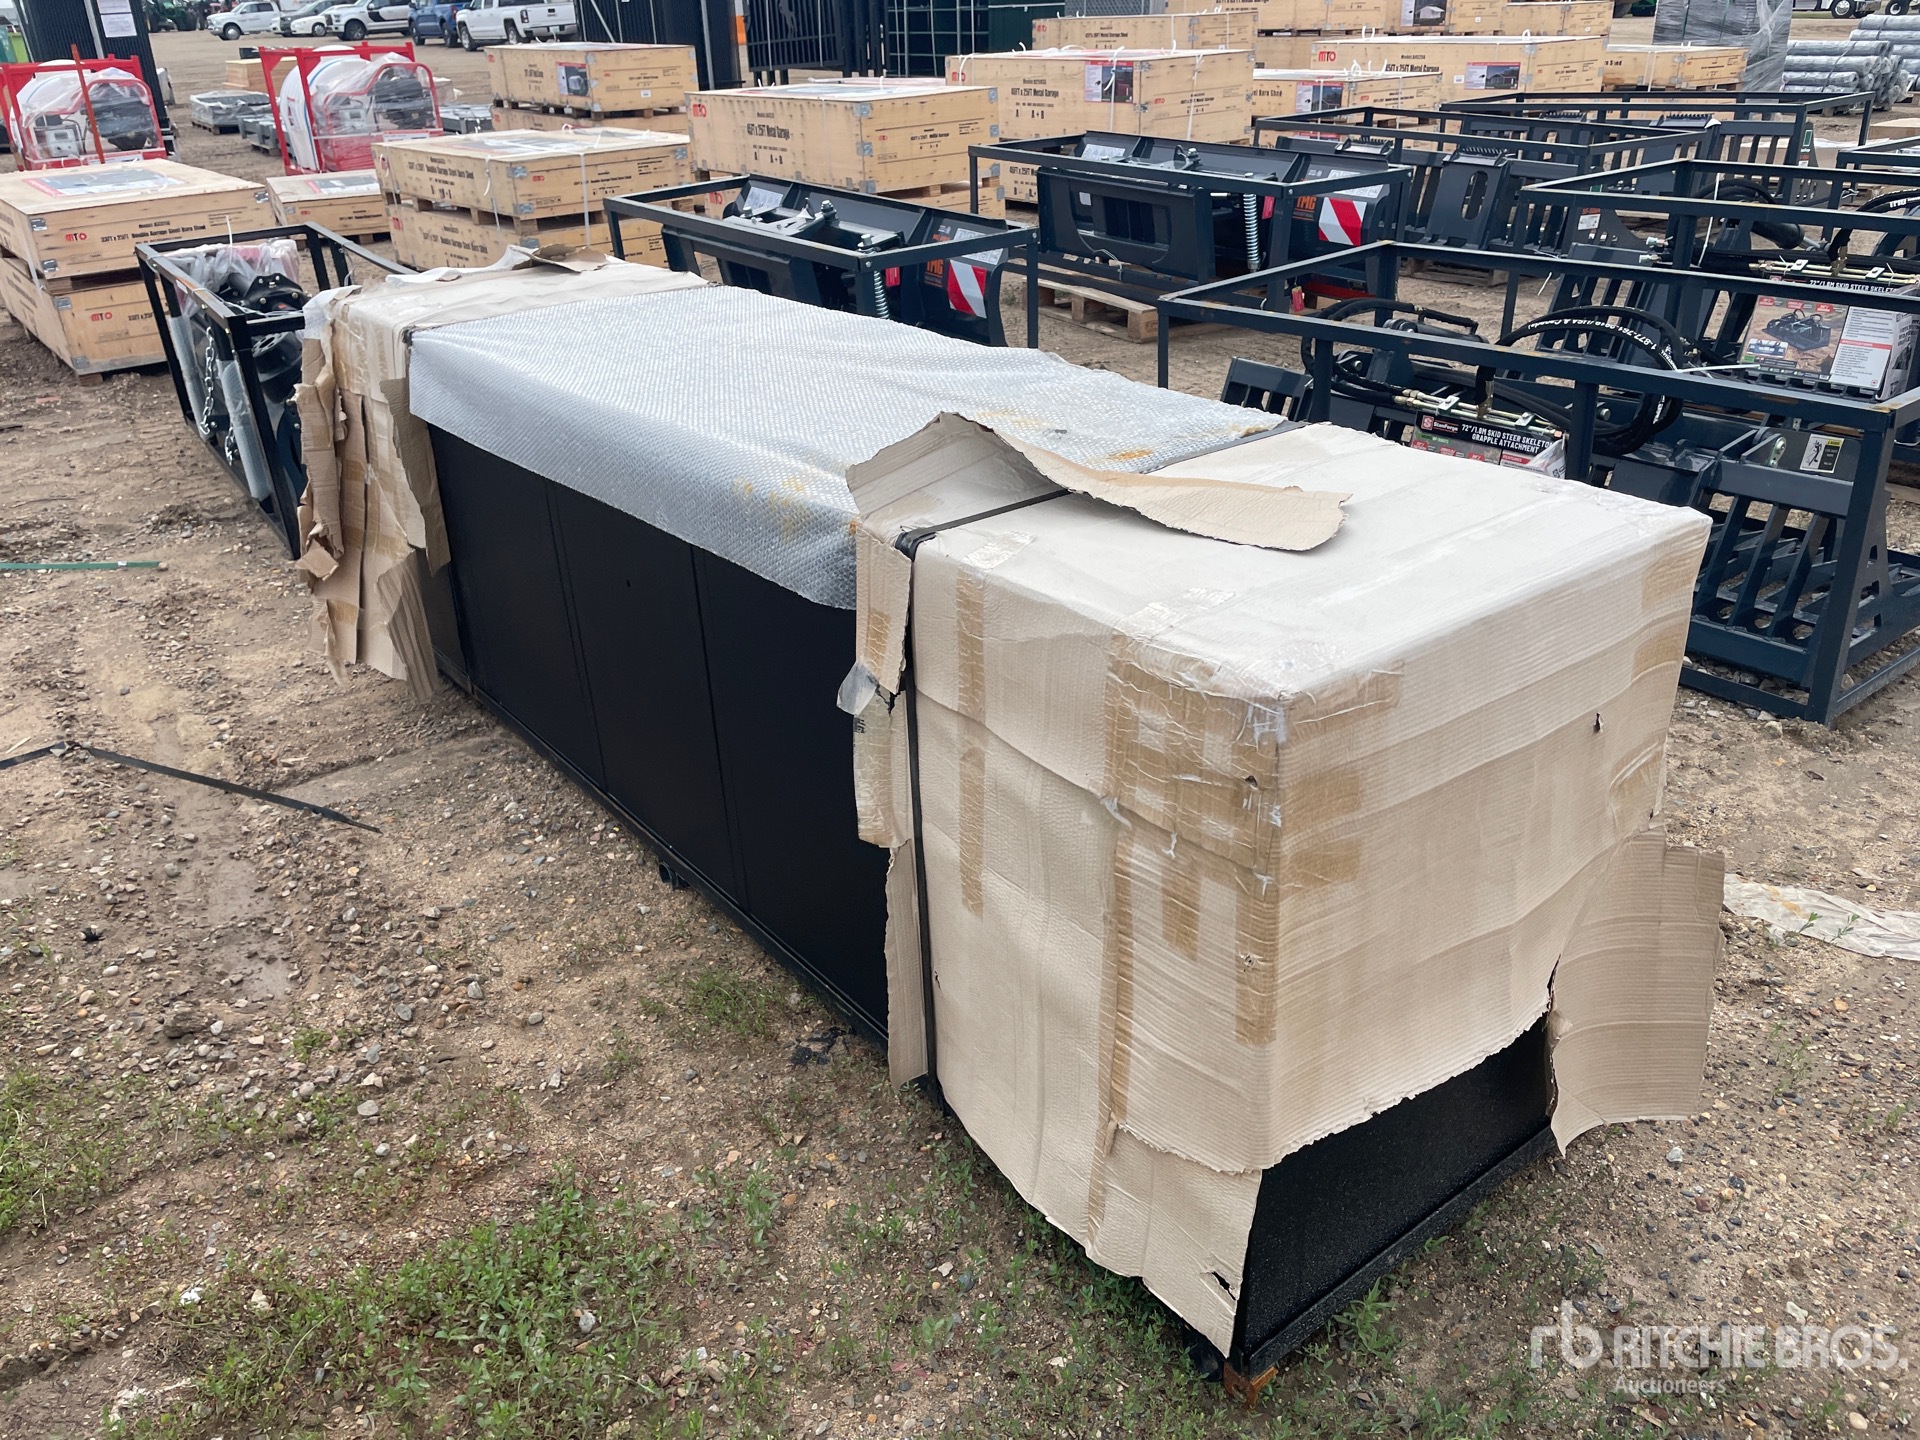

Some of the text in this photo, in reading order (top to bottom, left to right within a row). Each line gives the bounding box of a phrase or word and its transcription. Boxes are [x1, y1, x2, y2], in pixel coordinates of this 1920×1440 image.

[1318, 51, 1336, 62] MTO
[65, 232, 88, 242] MTO
[90, 311, 113, 322] MTO
[1434, 422, 1459, 432] StanForge
[1488, 429, 1501, 438] SKID
[1502, 432, 1522, 442] STEER
[1472, 433, 1539, 454] GRAPPLE ATTACHMENT
